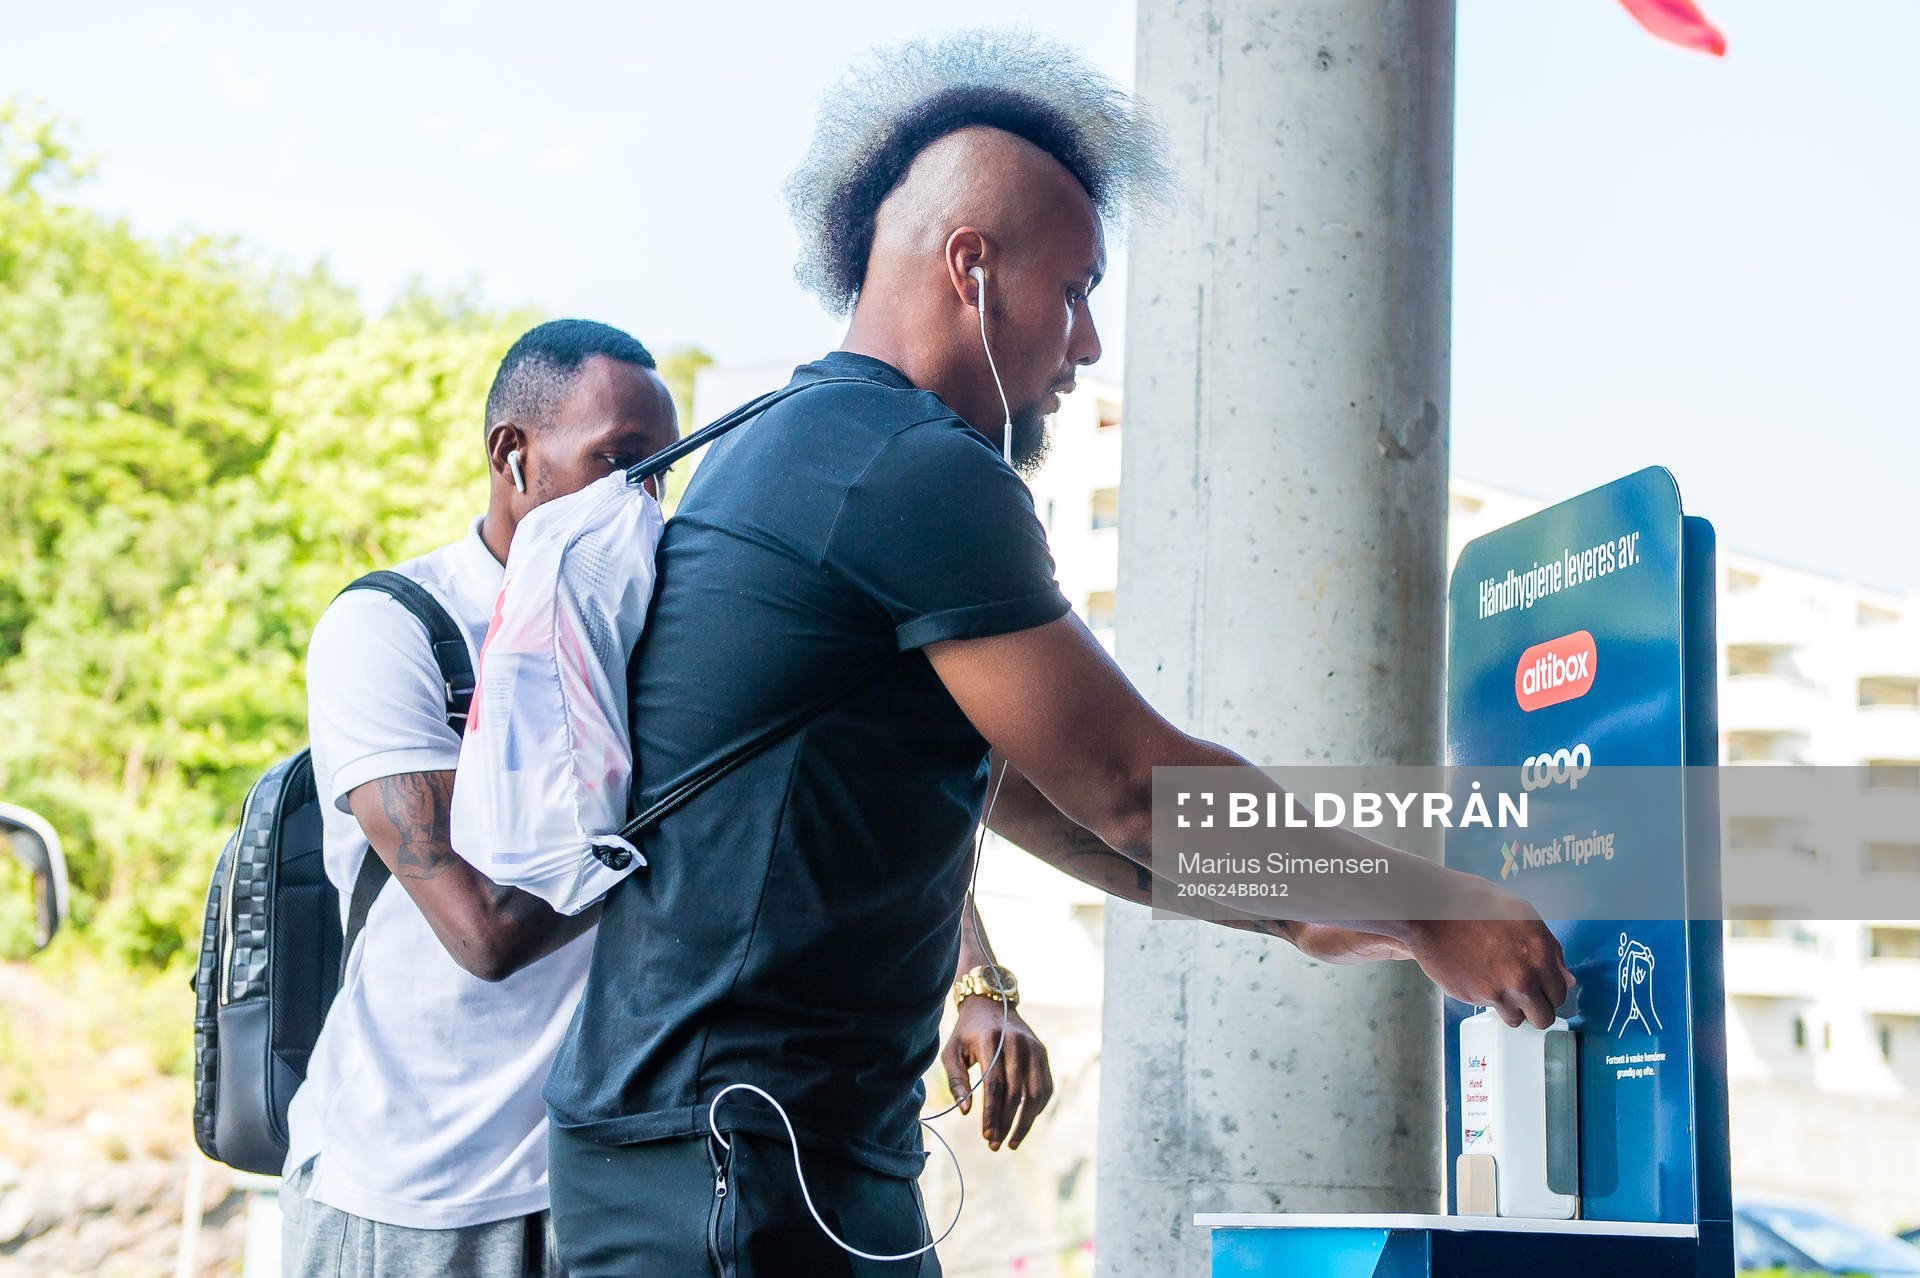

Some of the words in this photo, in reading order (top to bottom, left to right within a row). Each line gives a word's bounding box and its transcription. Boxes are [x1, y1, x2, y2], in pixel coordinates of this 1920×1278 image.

[1479, 562, 1562, 619] Håndhygiene
[1564, 540, 1615, 589] leveres
[1618, 531, 1640, 570] av:
[1522, 651, 1589, 695] altibox
[1520, 743, 1592, 791] coop
[1522, 838, 1562, 869] Norsk
[1562, 830, 1615, 866] Tipping
[1469, 1079, 1483, 1088] Hand
